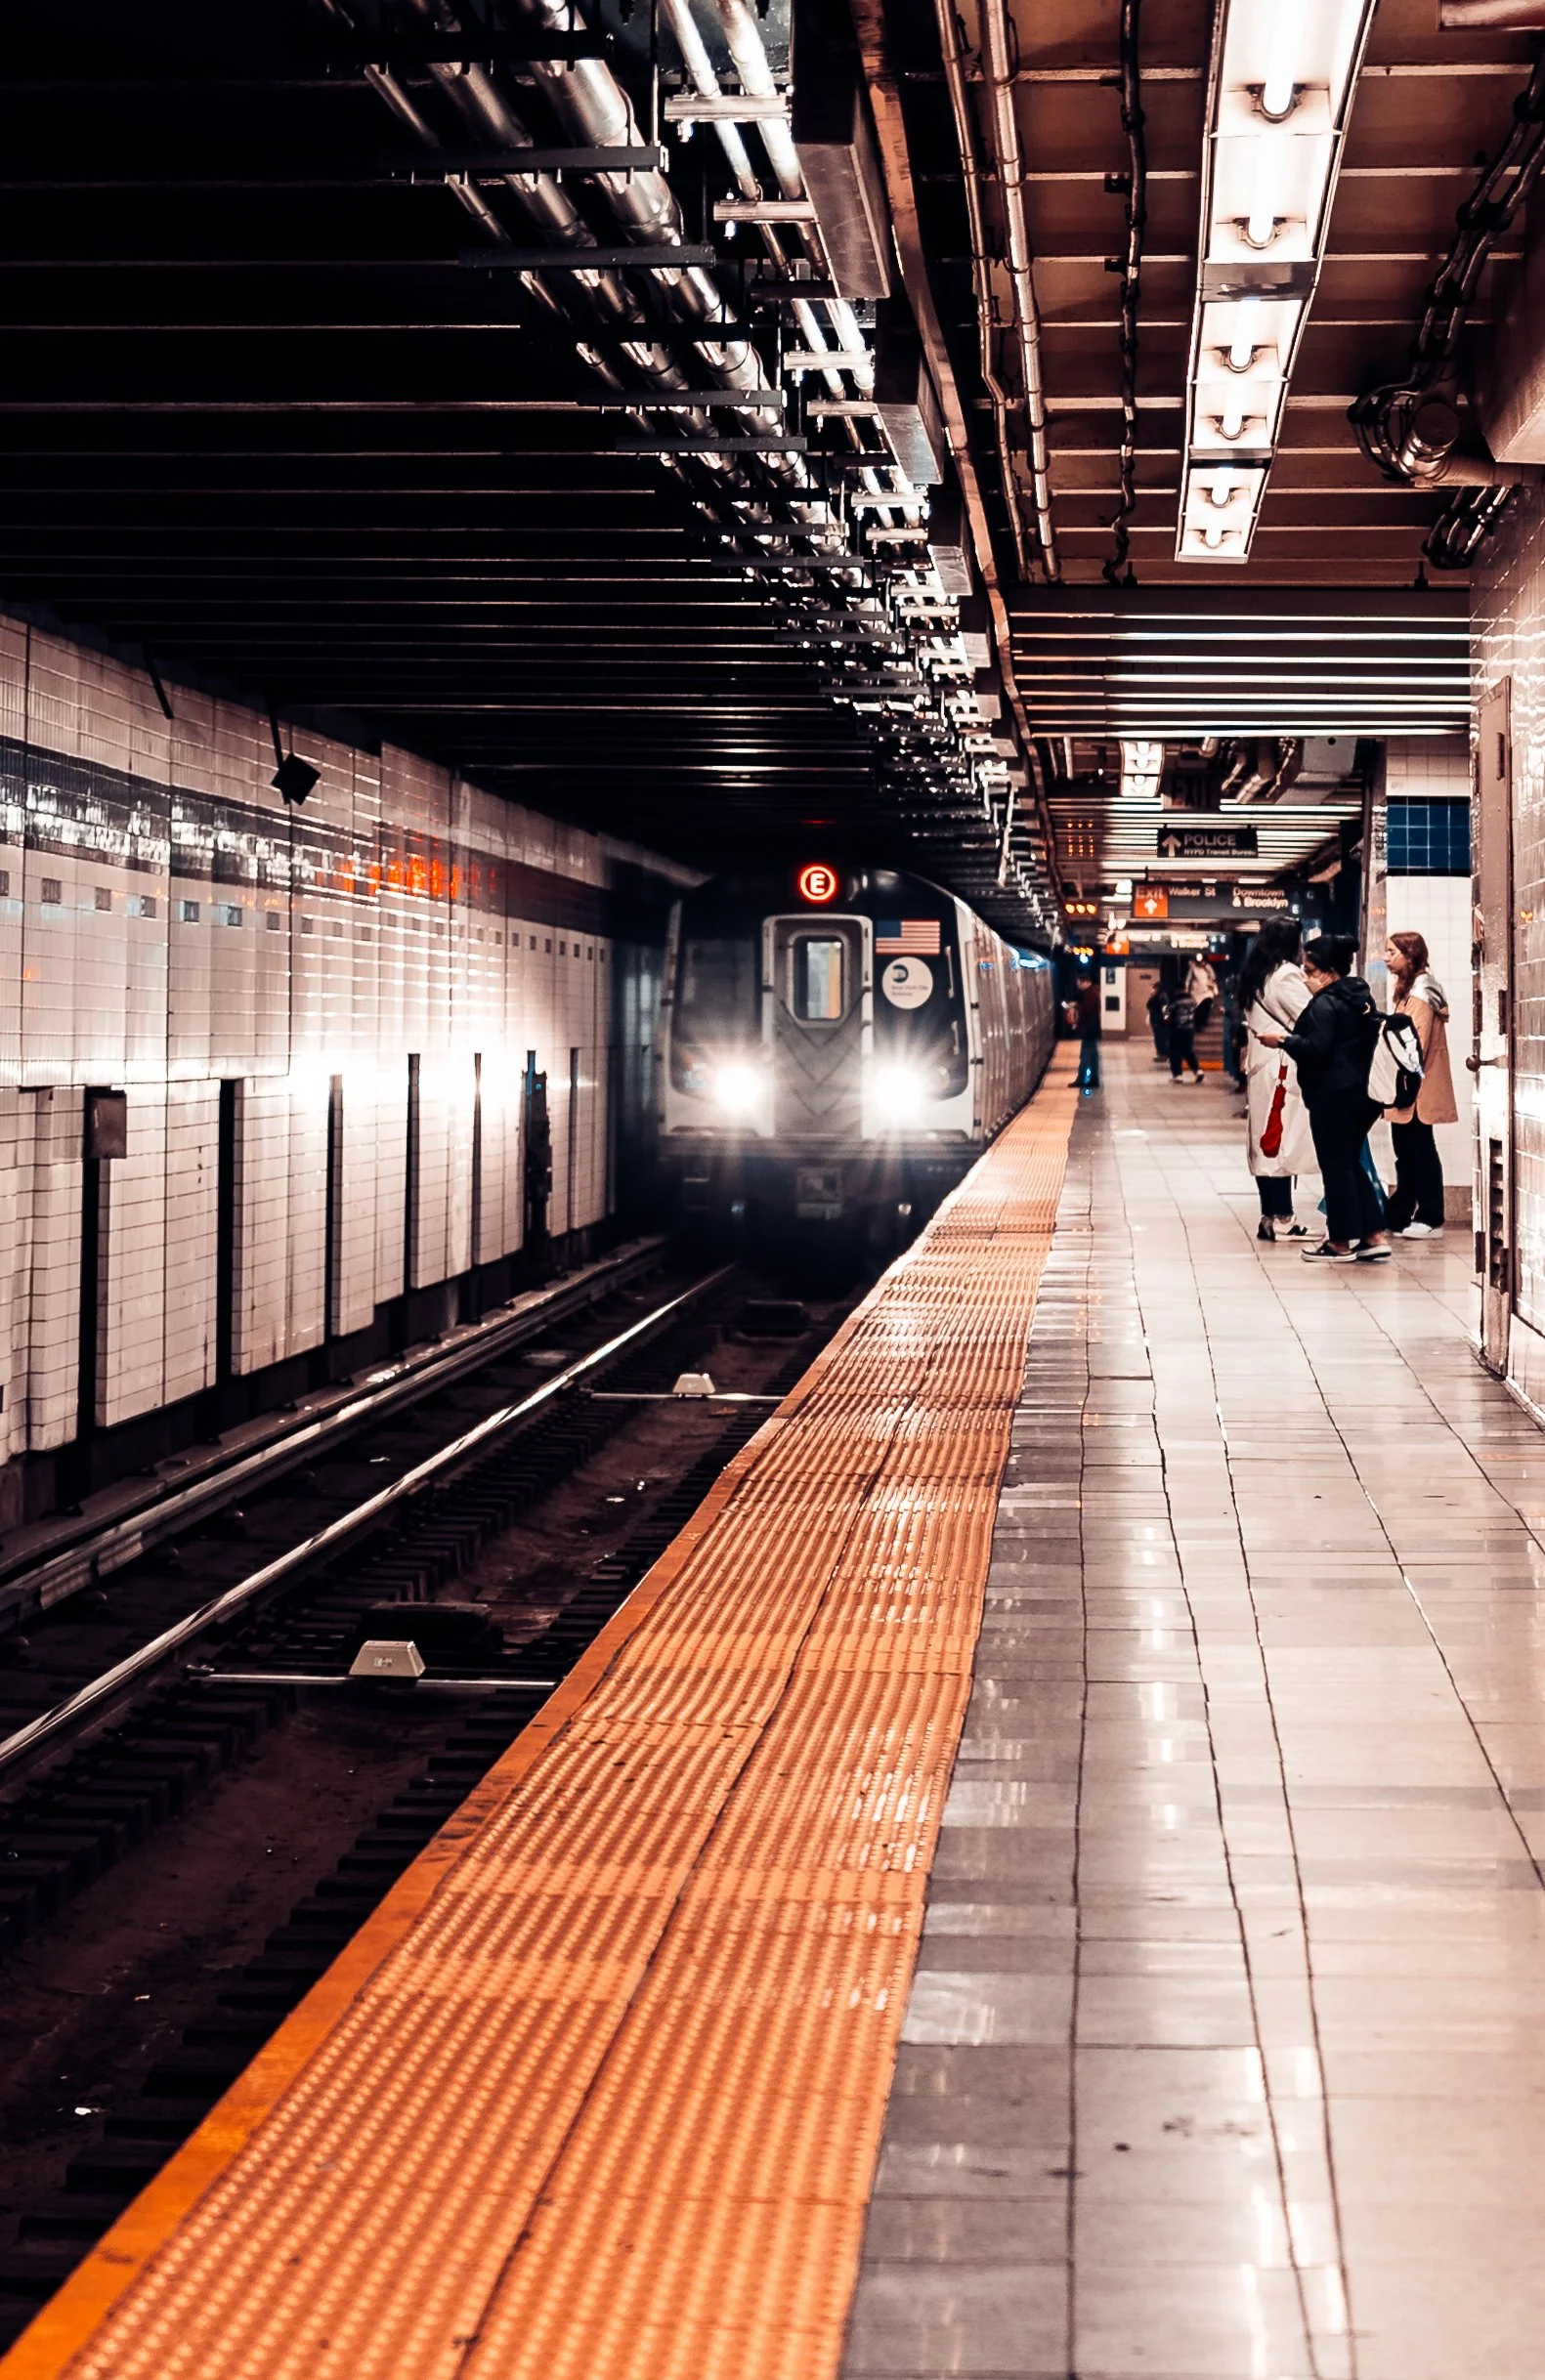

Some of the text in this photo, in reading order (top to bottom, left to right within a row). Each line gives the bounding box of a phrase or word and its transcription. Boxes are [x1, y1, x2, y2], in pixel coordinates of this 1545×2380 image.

[1183, 833, 1236, 846] POLICE
[810, 872, 826, 894] E
[1136, 886, 1164, 899] Exit
[1169, 887, 1217, 897] Walker St
[1232, 887, 1285, 897] Downtown
[1232, 896, 1289, 910] & Brooklyn
